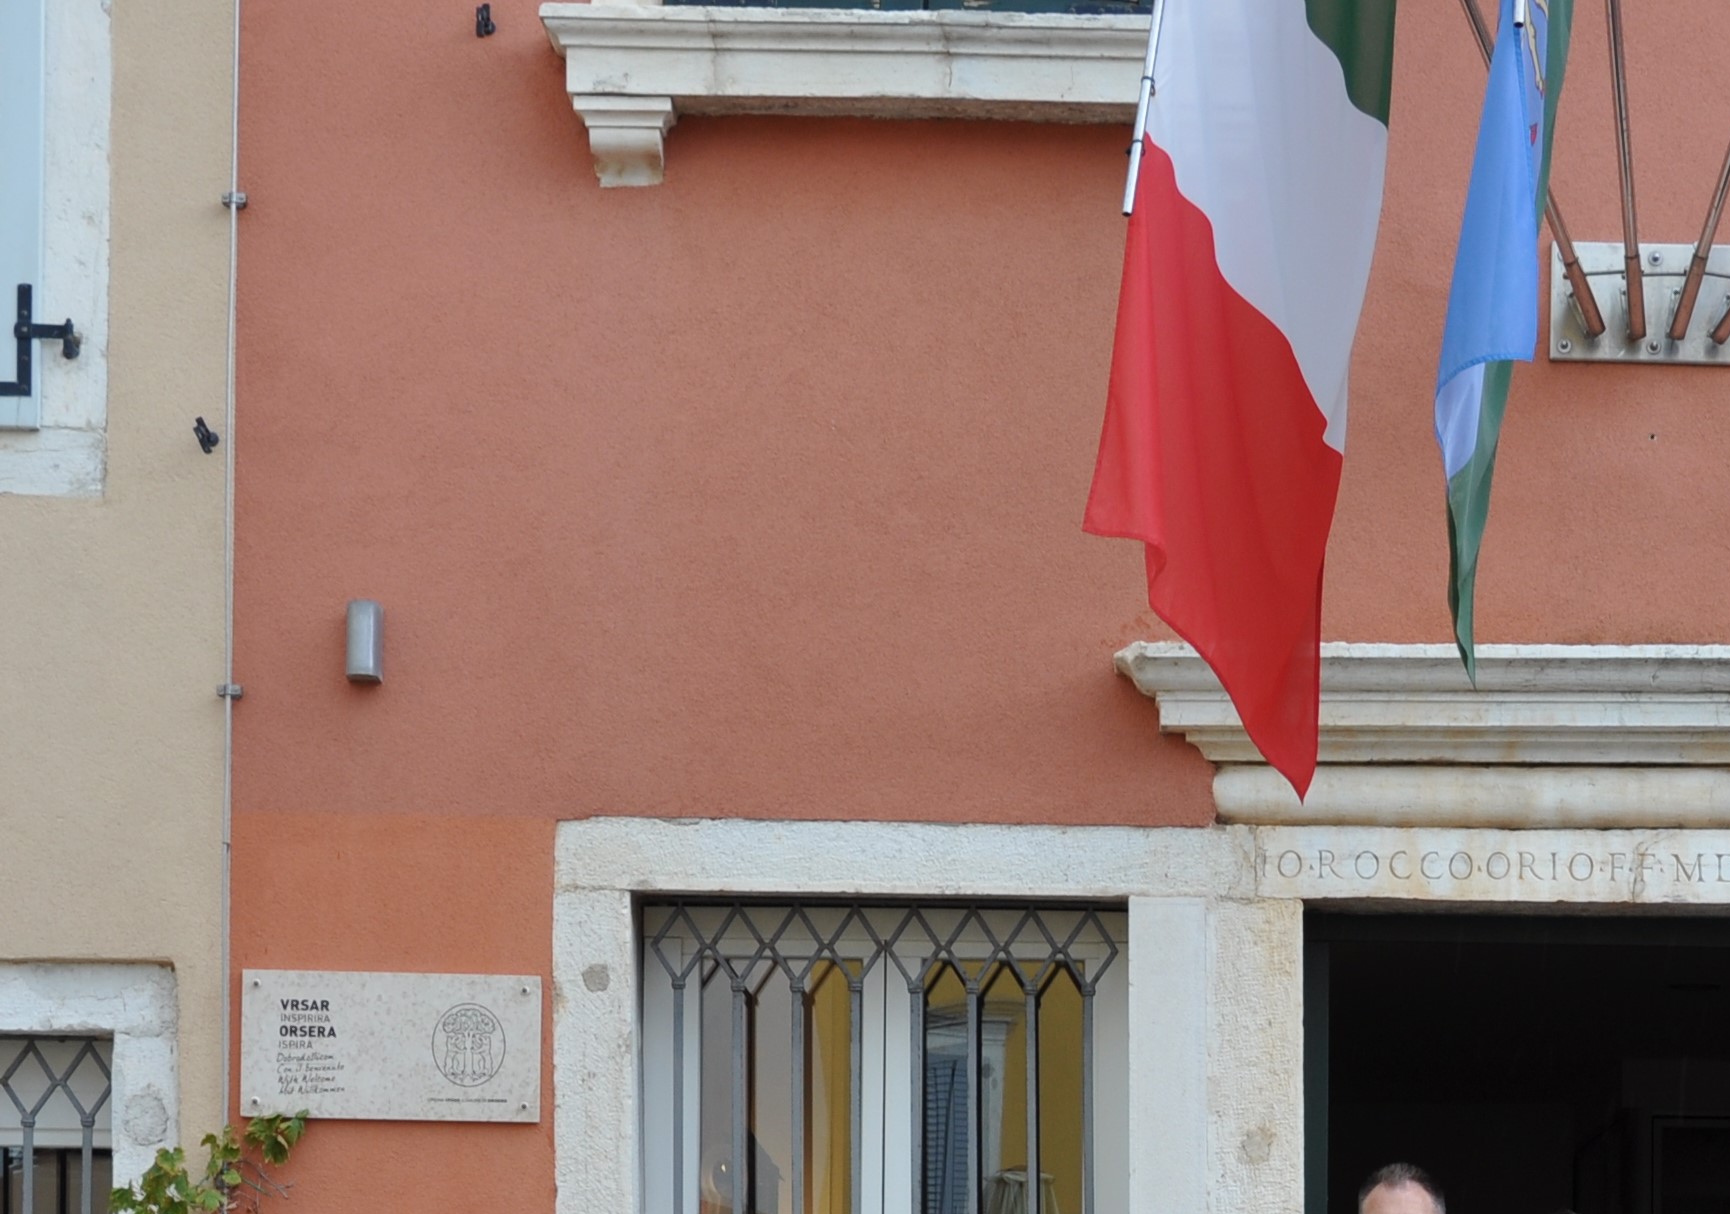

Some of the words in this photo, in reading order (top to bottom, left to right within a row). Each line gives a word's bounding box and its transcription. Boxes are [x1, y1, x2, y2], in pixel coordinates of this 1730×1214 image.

[280, 999, 330, 1011] VRSAR
[280, 1013, 330, 1022] INSPIRIRA
[279, 1025, 336, 1038] ORSERA
[278, 1040, 313, 1049] ISPIRA
